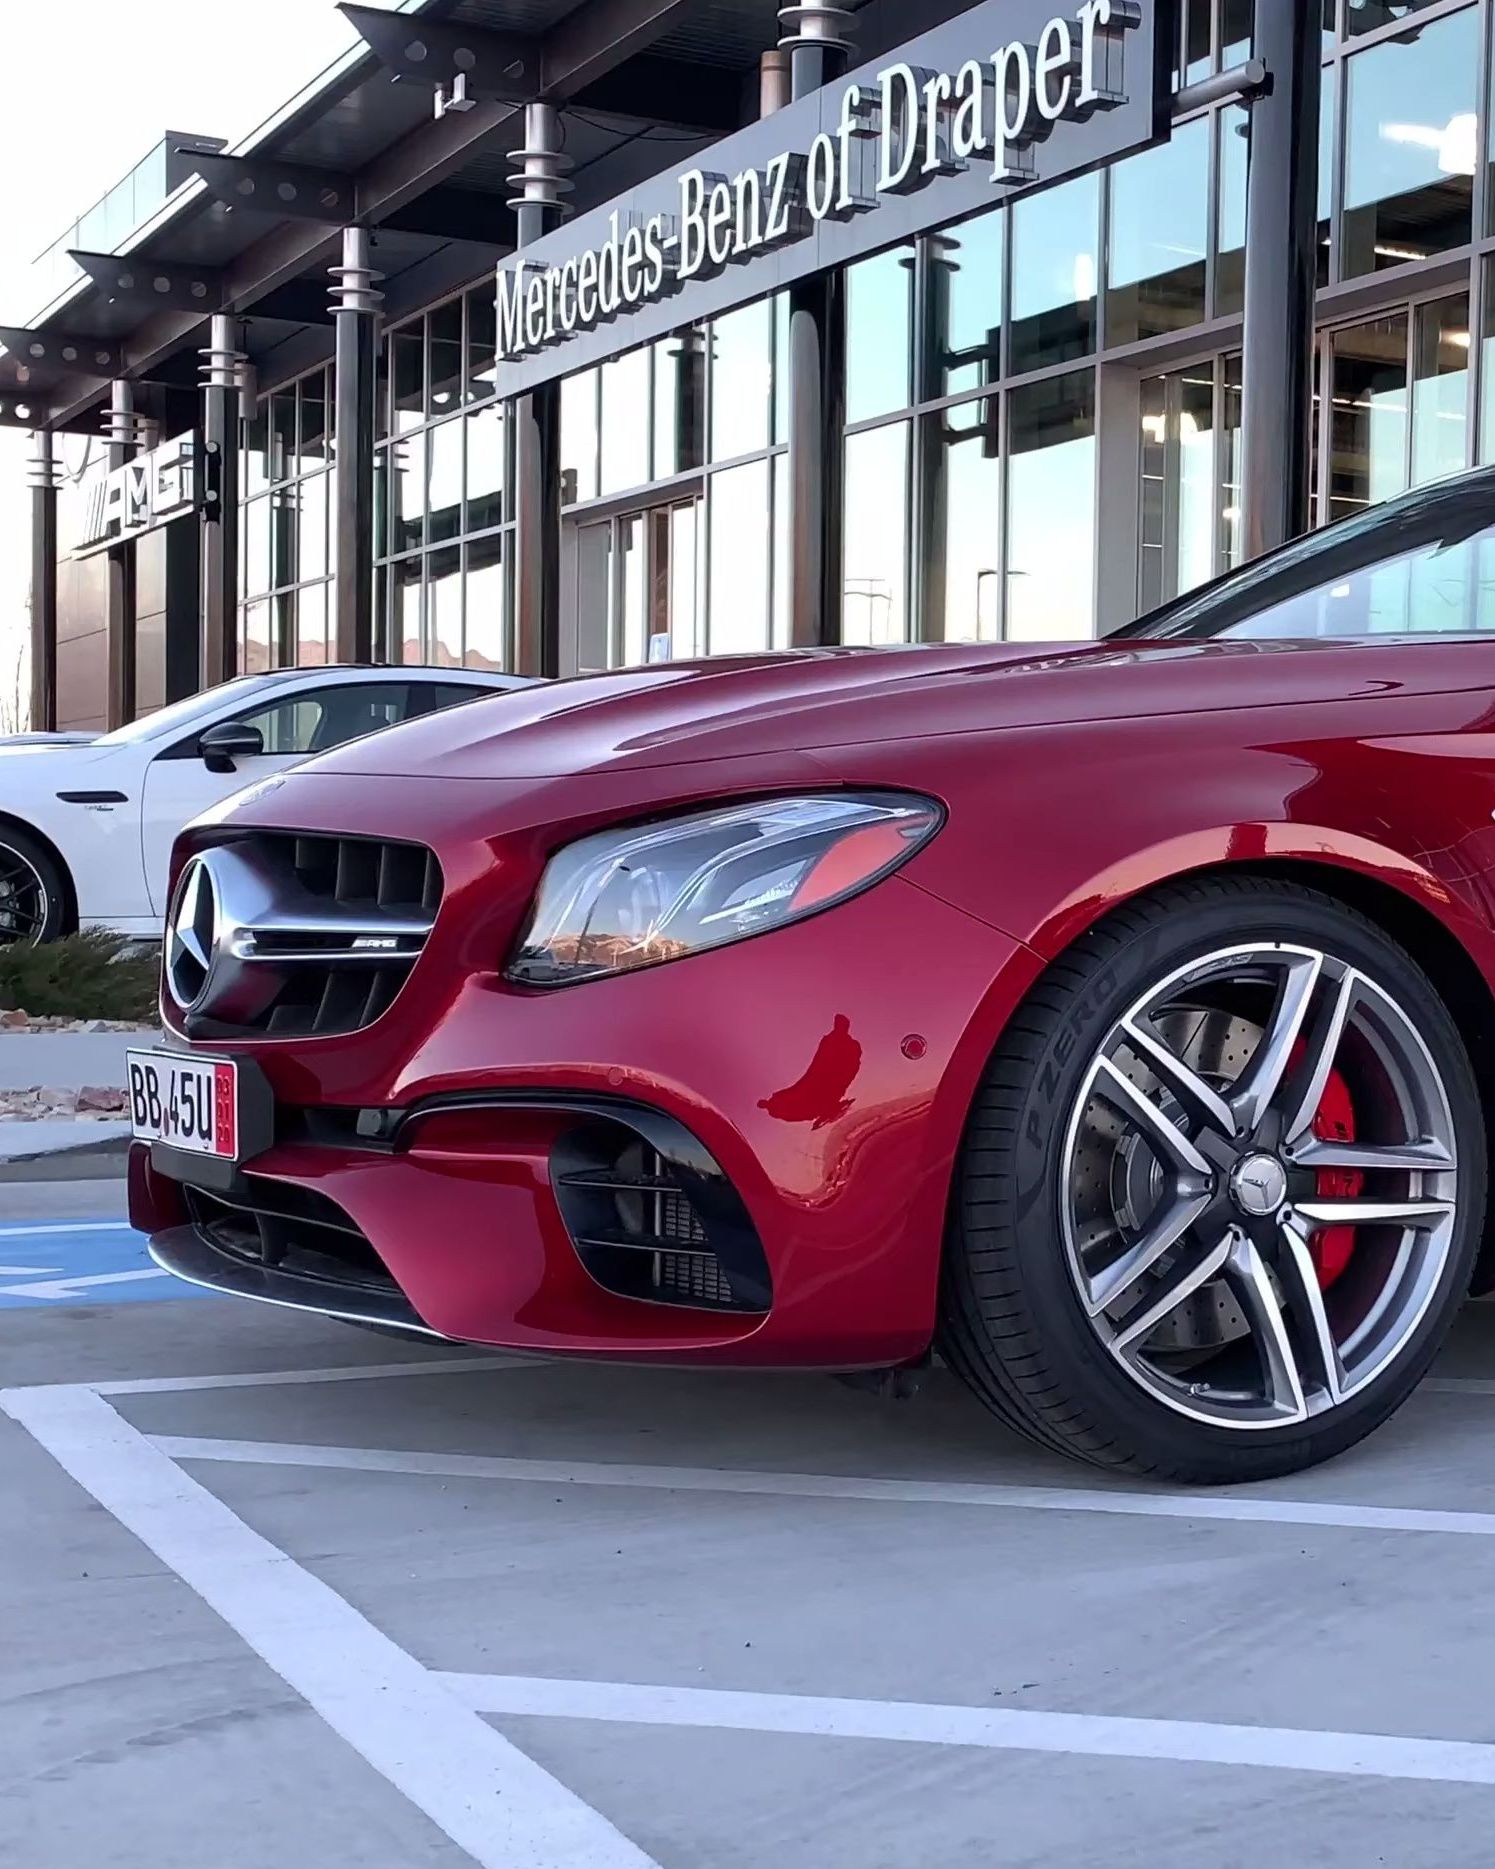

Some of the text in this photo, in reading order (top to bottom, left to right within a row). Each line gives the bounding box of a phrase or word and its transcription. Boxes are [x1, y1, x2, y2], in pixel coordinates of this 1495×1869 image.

[495, 0, 1112, 362] Mercedes-Benz of Draper
[130, 1063, 162, 1129] BB
